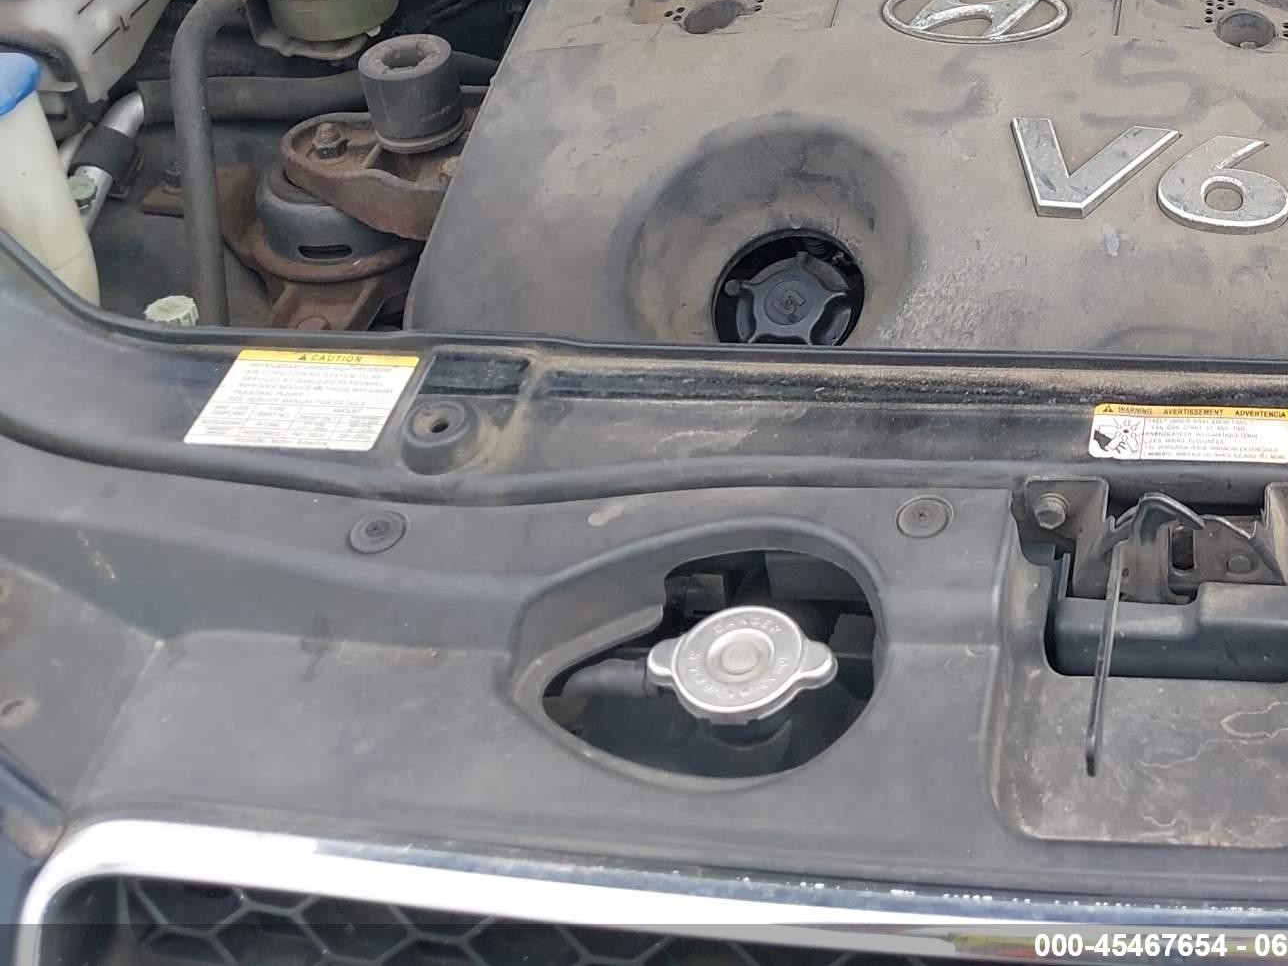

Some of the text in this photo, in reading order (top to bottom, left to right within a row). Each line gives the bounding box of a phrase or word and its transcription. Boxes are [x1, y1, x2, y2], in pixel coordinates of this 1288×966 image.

[120, 16, 130, 32] L
[310, 354, 362, 363] CAUTION
[1118, 406, 1152, 415] WARNING
[1235, 410, 1286, 418] ADVERTENCIA
